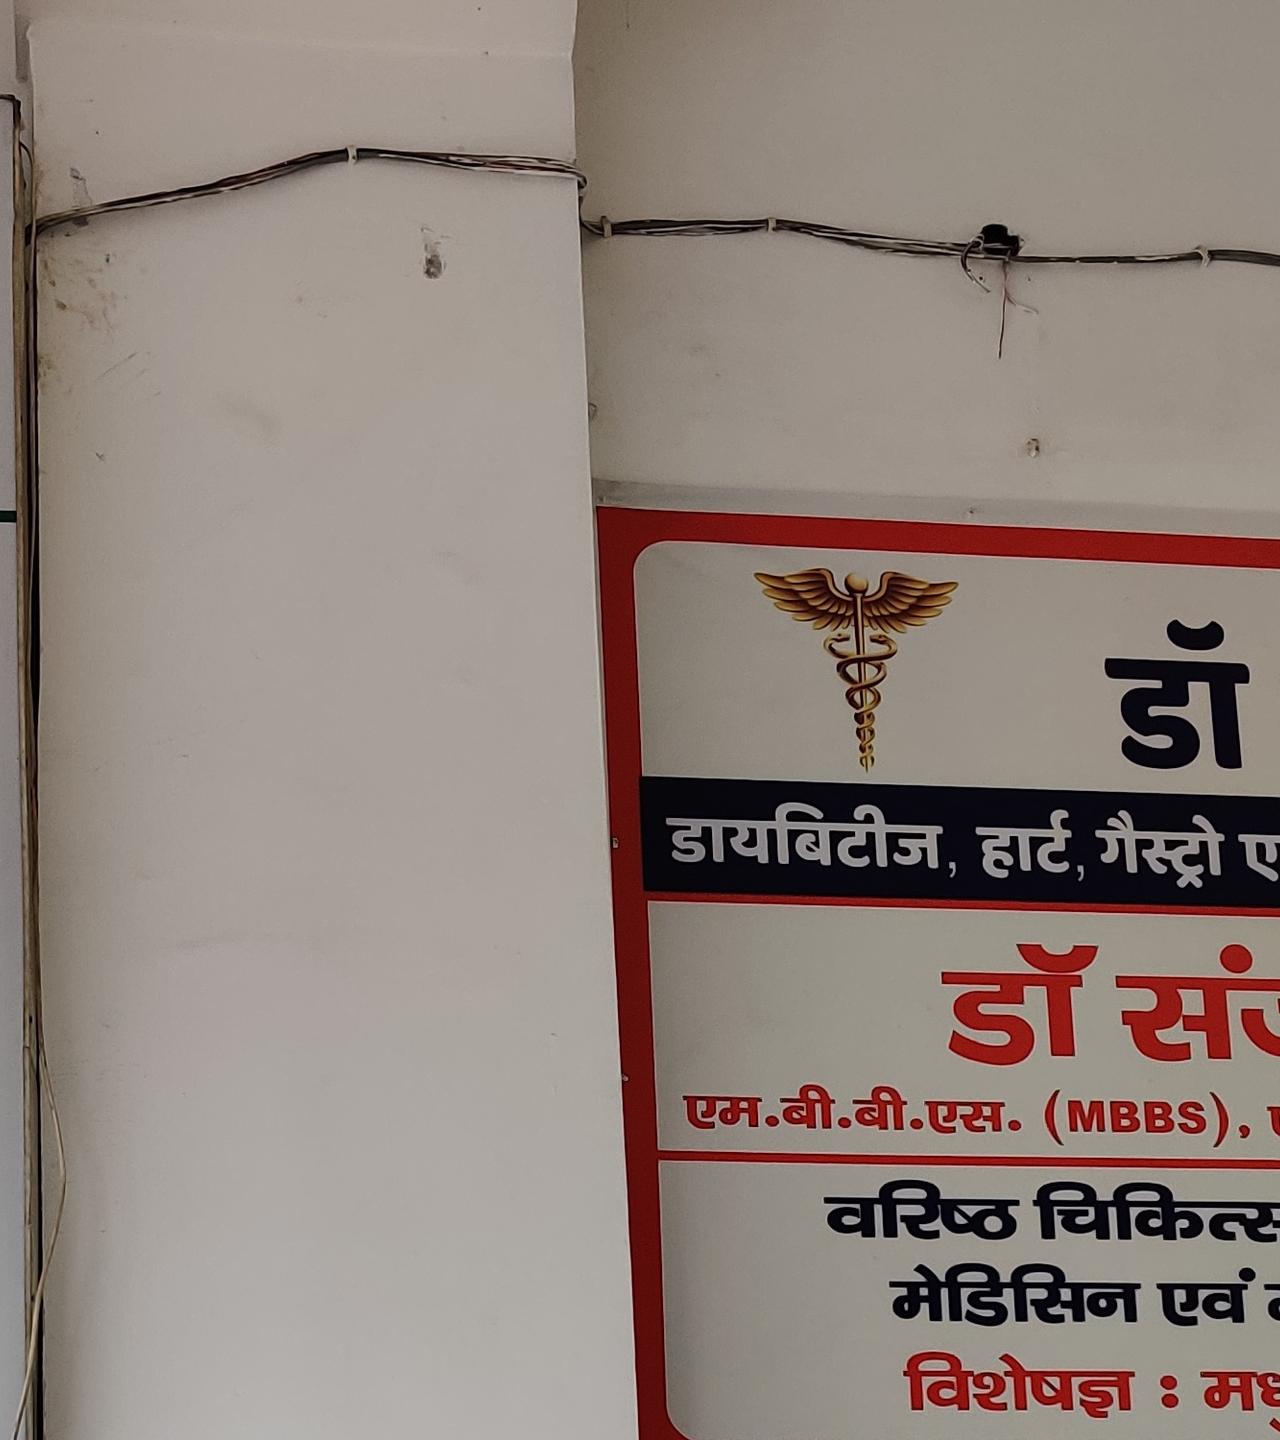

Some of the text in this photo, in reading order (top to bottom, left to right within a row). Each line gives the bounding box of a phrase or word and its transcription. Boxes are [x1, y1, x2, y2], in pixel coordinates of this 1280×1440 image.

[1104, 619, 1250, 770] डॉ
[666, 802, 956, 877] डायबिटीज,
[975, 811, 1085, 881] हार्ट,
[1095, 811, 1225, 888] गैस्ट्रो
[941, 944, 1099, 1066] डॉ
[682, 1084, 1021, 1133] एम.बी.बी.एस.
[1043, 1089, 1250, 1147] (MBBS),
[824, 1179, 1020, 1241] वरिष्ठ
[889, 1263, 1140, 1325] मेडिसिन
[1157, 1267, 1257, 1326] एवं
[904, 1351, 1135, 1420] विशेषज्ञ
